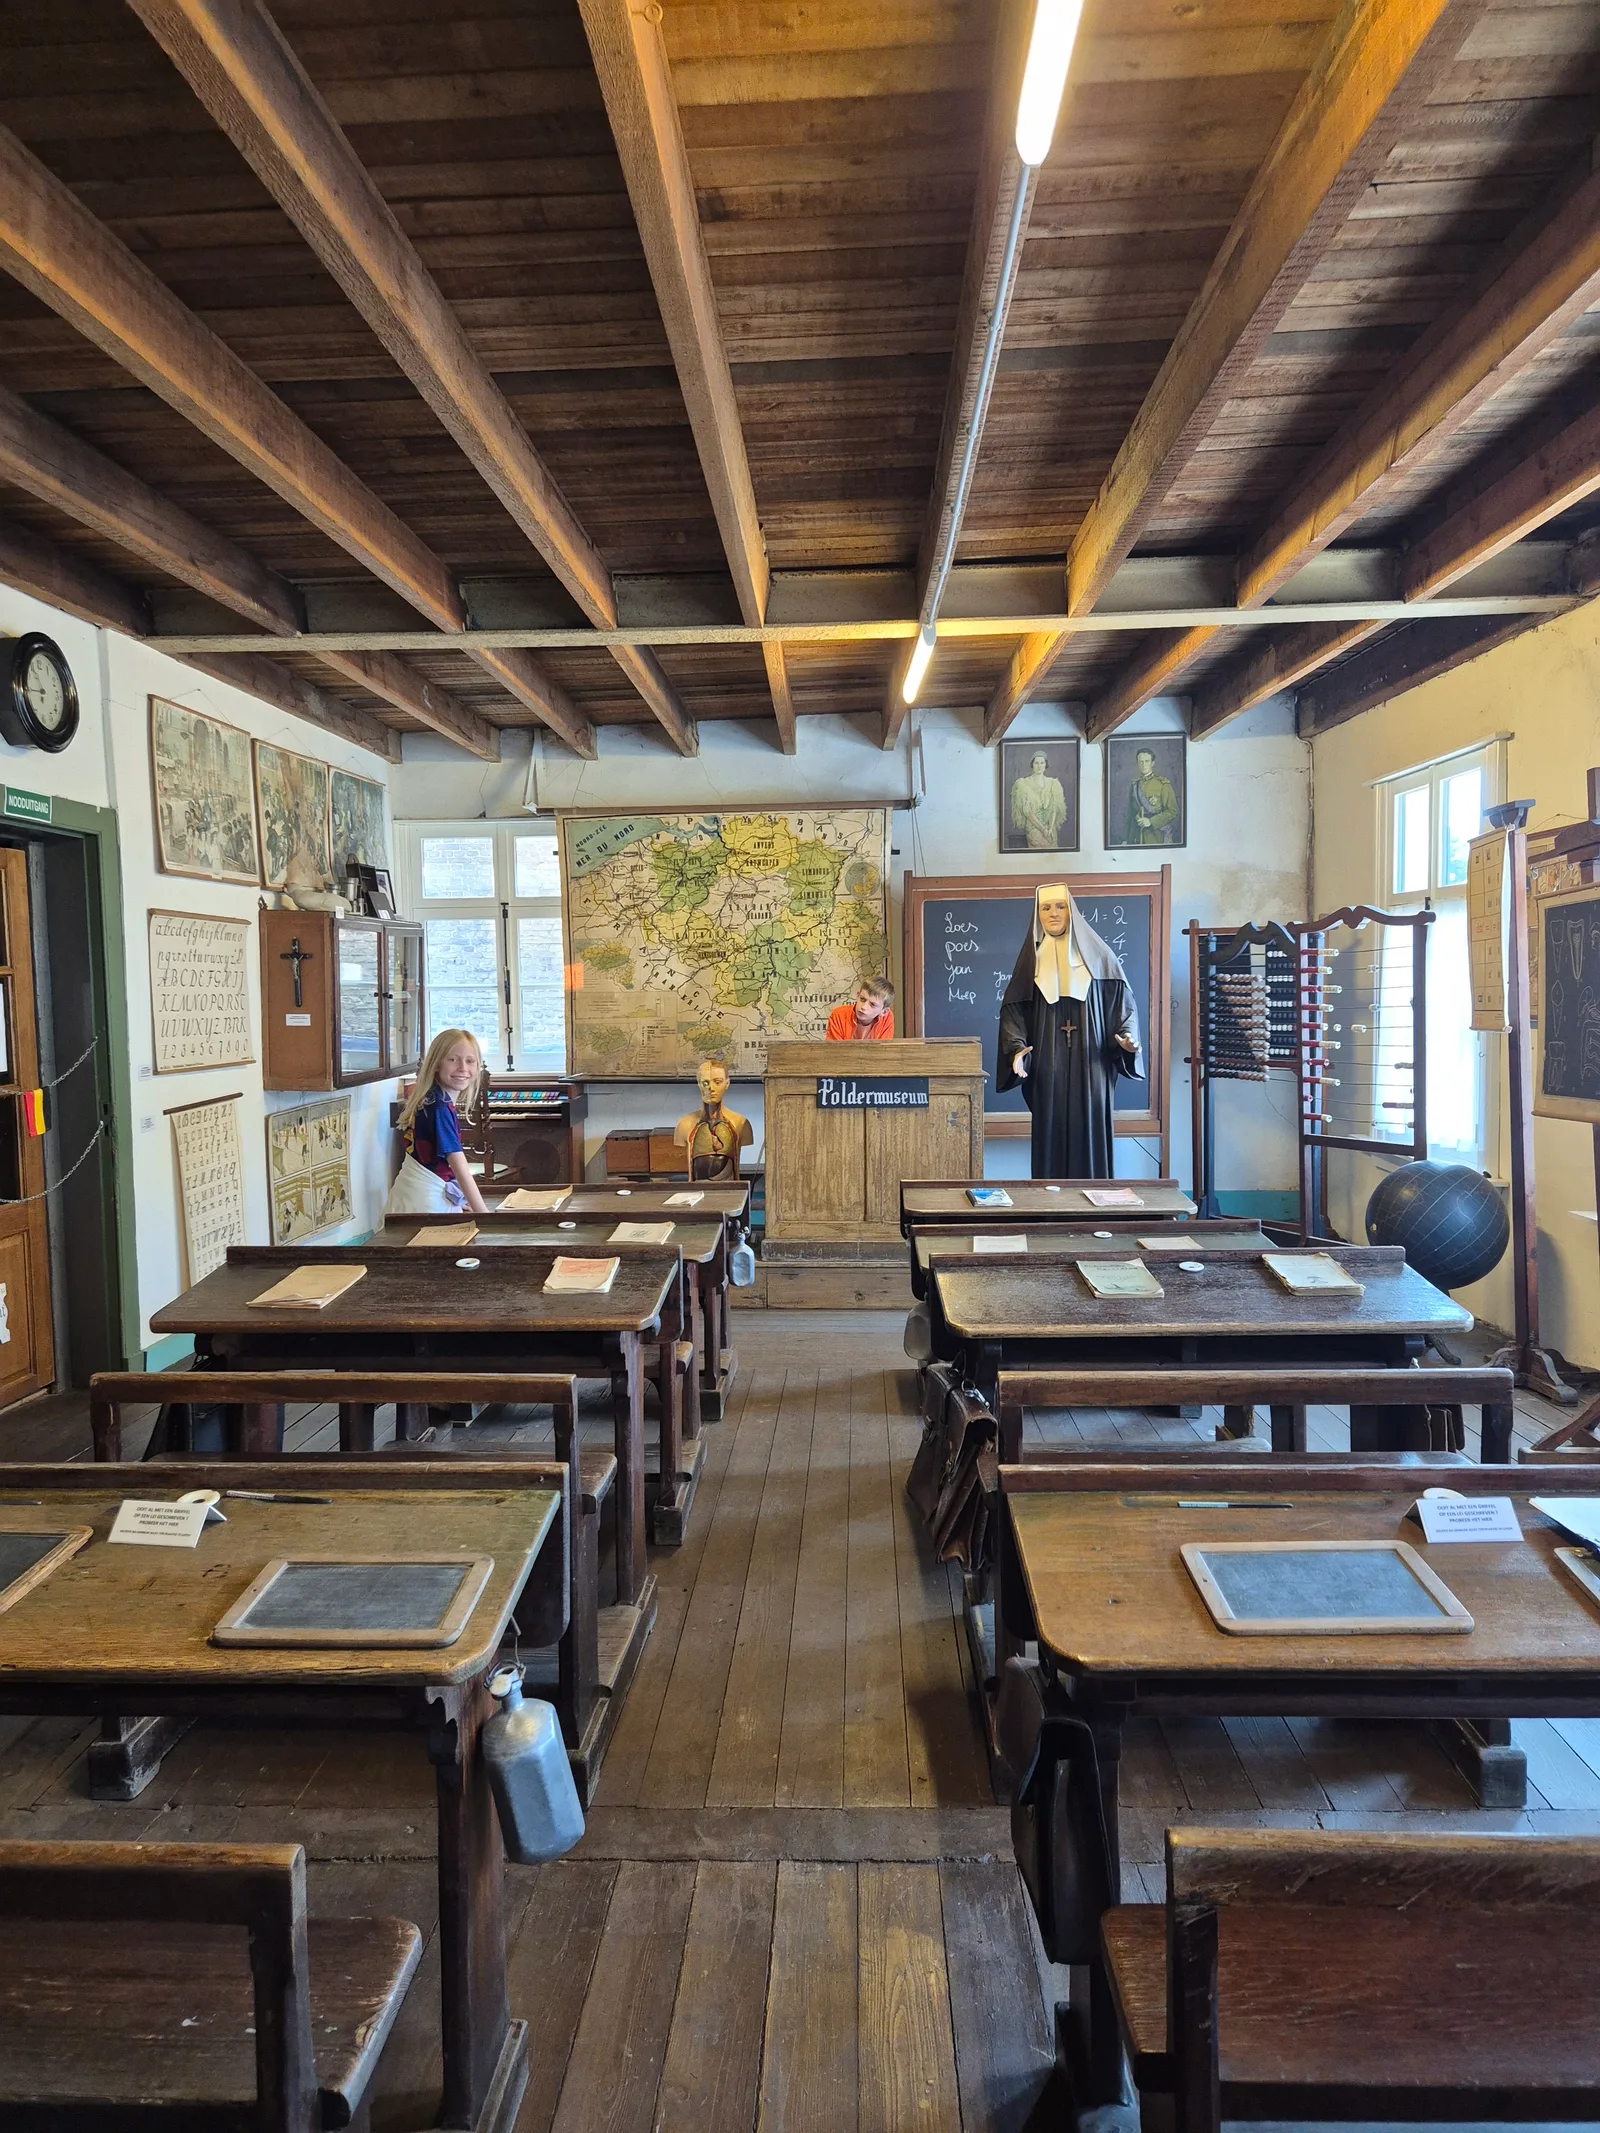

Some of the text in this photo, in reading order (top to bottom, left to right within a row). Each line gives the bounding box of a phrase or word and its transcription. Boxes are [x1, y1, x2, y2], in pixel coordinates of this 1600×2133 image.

[8, 795, 49, 814] NOODUITGANG
[576, 824, 635, 868] MER DU NORD
[944, 912, 979, 933] Loes
[1113, 905, 1128, 925] 2
[944, 940, 980, 961] poes
[1112, 932, 1127, 950] 4
[949, 987, 977, 1005] Miep
[818, 1078, 929, 1106] Poldermuseum
